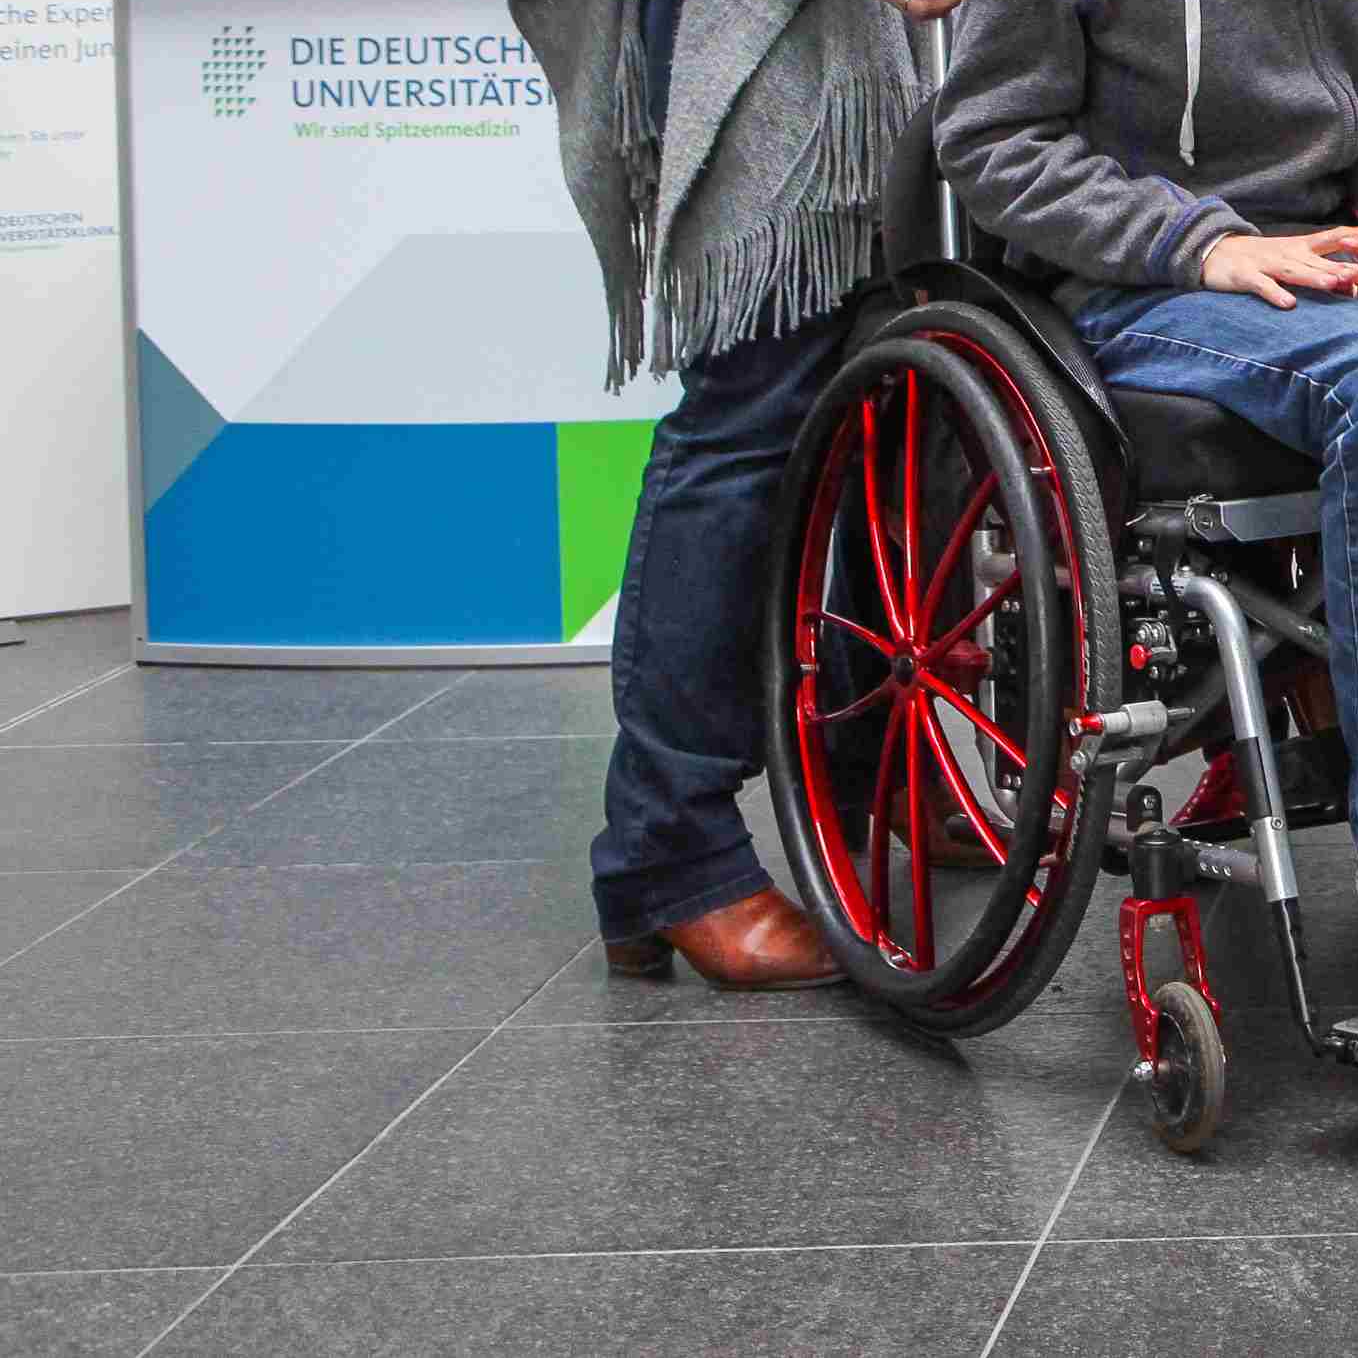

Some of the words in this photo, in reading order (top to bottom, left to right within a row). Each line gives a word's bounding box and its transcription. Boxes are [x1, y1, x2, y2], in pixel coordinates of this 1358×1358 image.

[291, 38, 346, 65] DIE
[357, 36, 541, 65] DEUTSCH
[294, 122, 326, 138] Wir
[329, 121, 369, 138] sind
[375, 118, 520, 142] Spitzenmedizin
